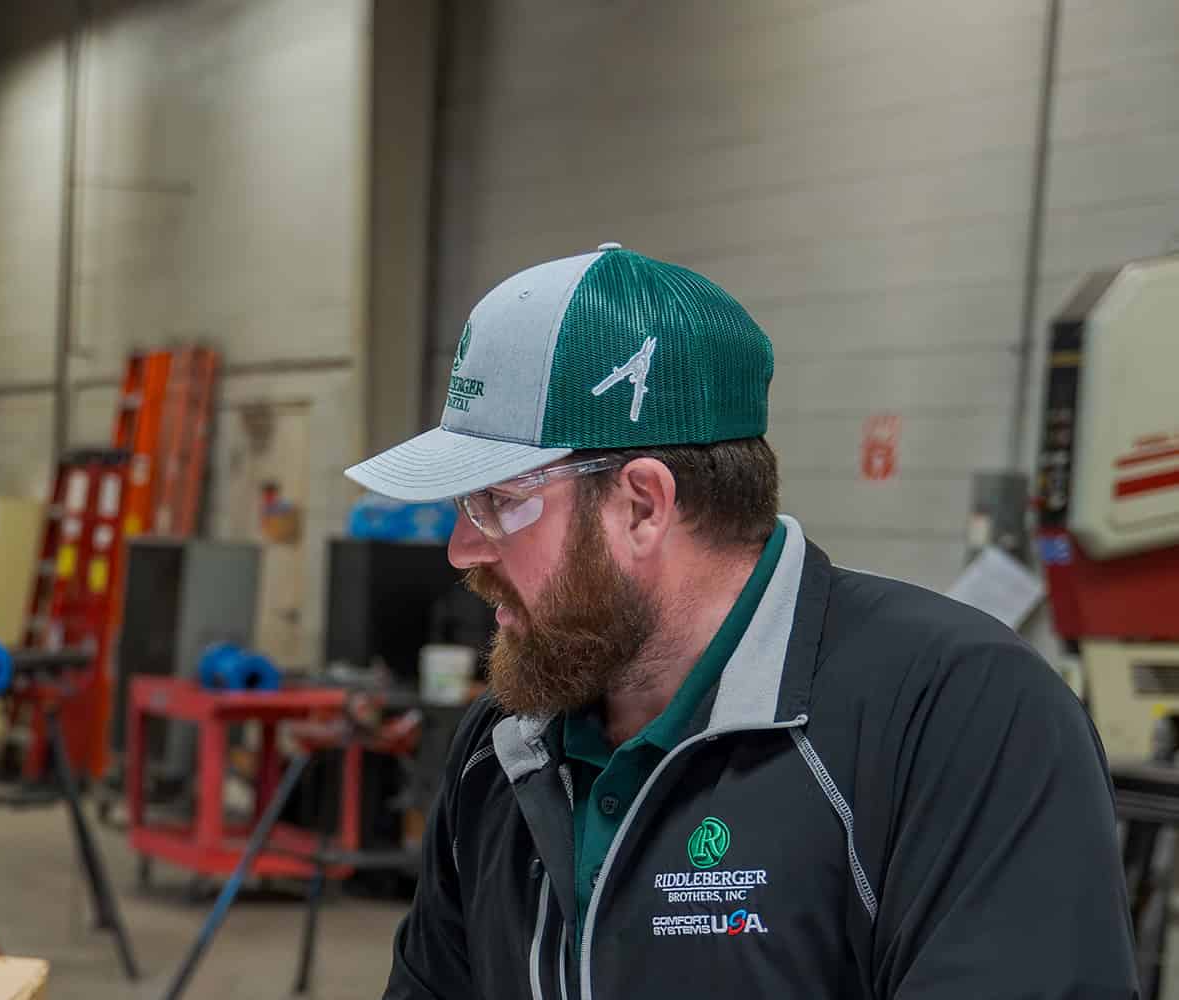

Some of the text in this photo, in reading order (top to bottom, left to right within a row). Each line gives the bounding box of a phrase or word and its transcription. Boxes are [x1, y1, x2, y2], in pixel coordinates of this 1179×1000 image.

[654, 870, 767, 888] RIDDLEBERGER
[668, 890, 747, 903] BROTHERS, INC
[652, 915, 710, 926] COMFORT
[653, 926, 711, 936] SYSTEMS
